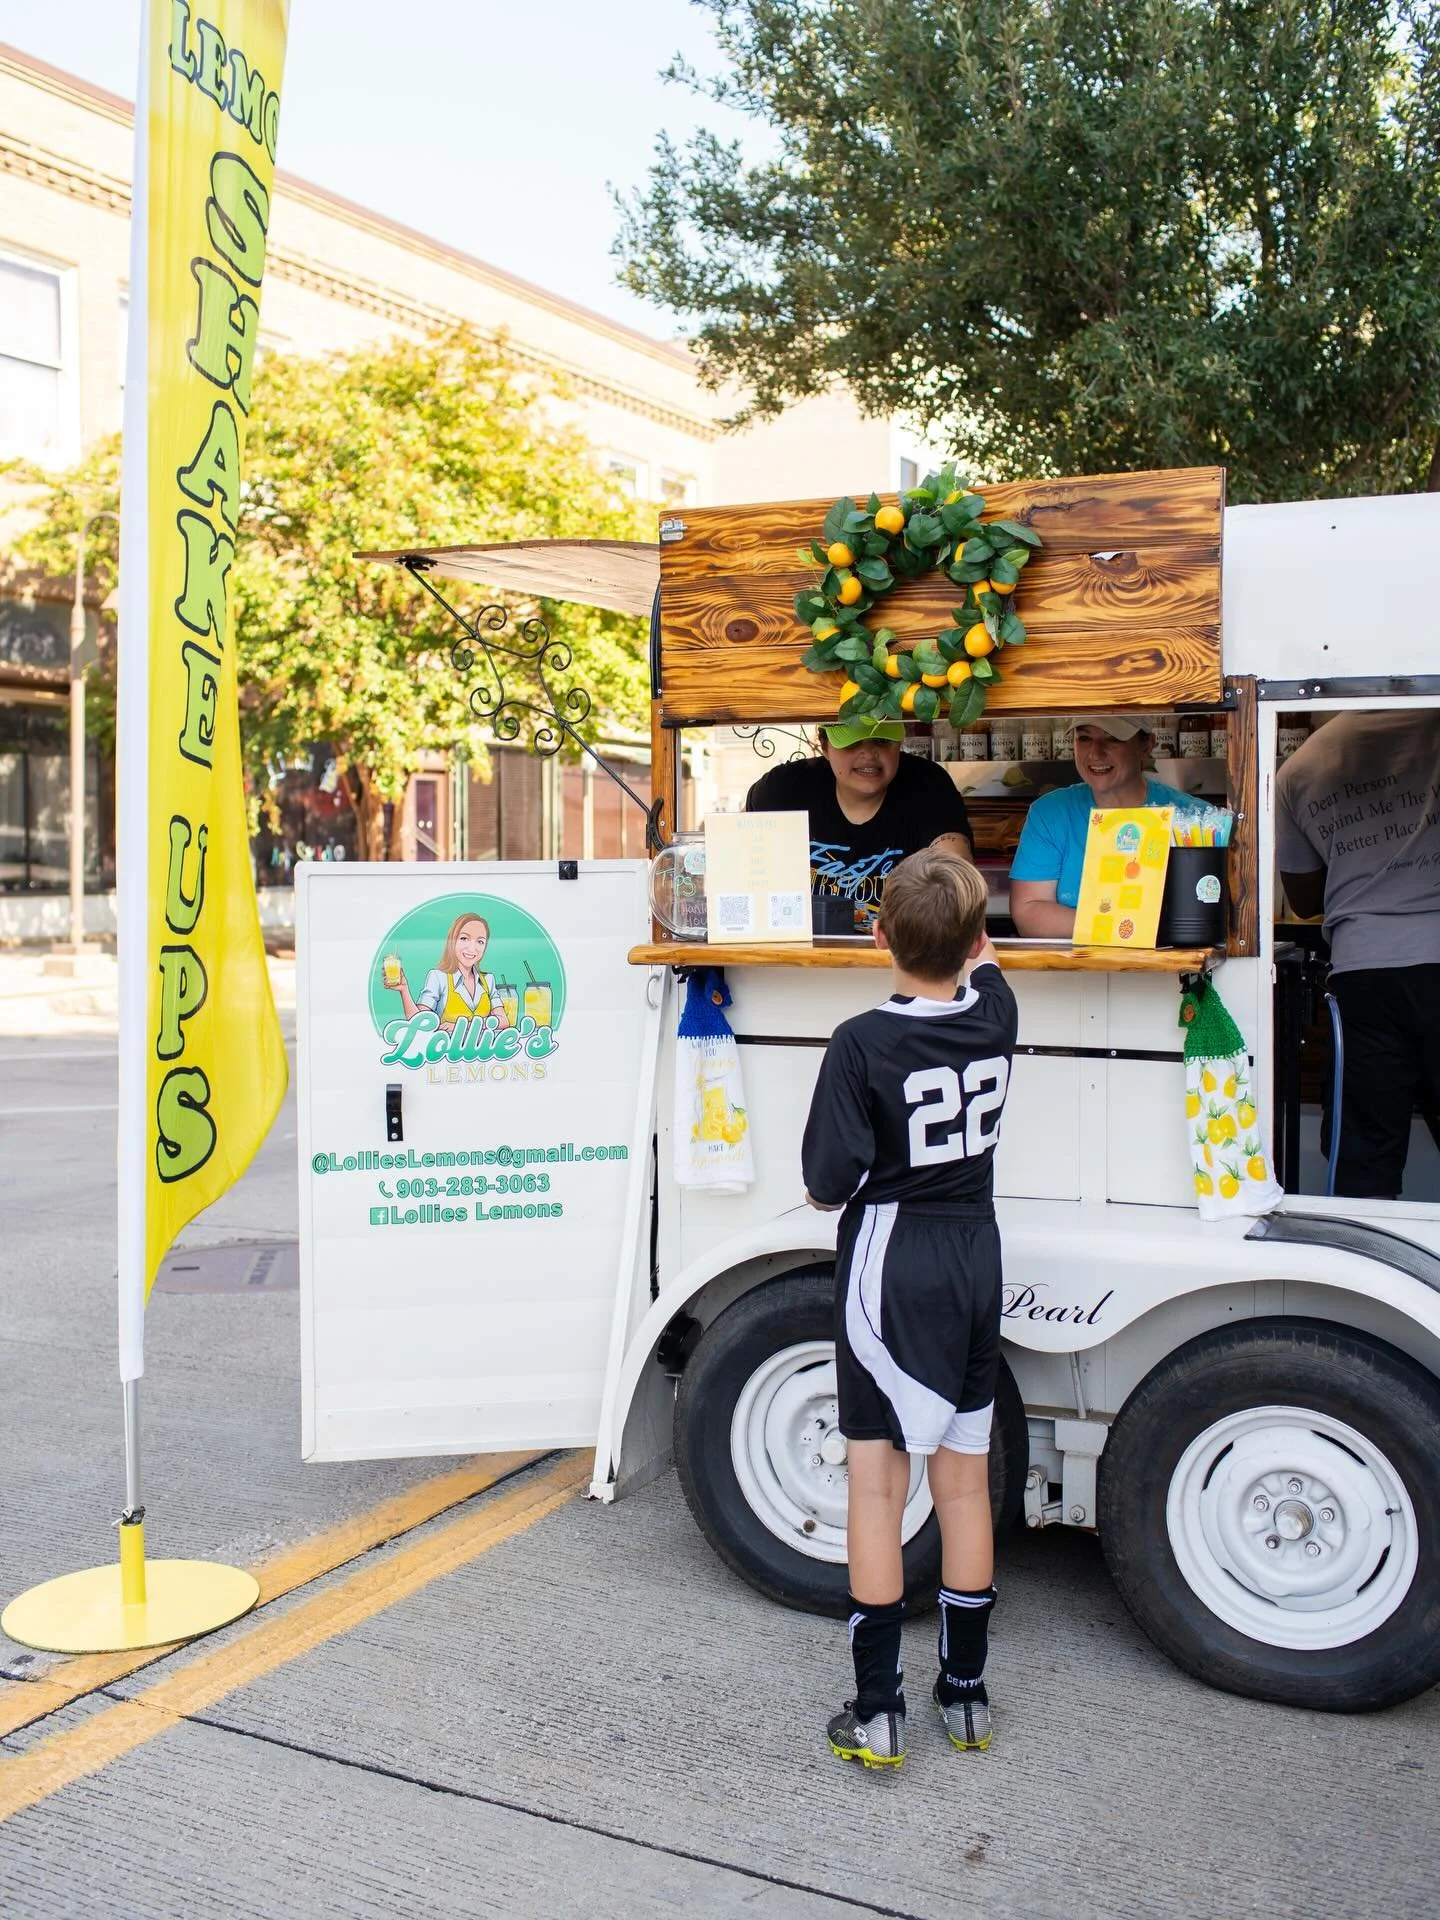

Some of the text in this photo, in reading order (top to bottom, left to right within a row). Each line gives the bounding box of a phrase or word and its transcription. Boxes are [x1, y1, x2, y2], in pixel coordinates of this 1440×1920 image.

[1307, 790, 1340, 818] Dear
[1343, 774, 1397, 799] Person
[1369, 800, 1393, 818] Me
[1395, 790, 1427, 809] The
[1335, 833, 1379, 856] Better
[810, 841, 904, 899] Fast
[380, 1009, 559, 1070] Lollie's
[426, 1061, 548, 1085] LEMONS
[903, 1055, 1009, 1168] 22
[312, 1143, 629, 1174] @LolliesLemons@gmail.com
[396, 1173, 551, 1199] 903-283-3063
[391, 1204, 468, 1225] Lollies
[475, 1201, 564, 1222] Lemons
[1001, 1282, 1114, 1325] Pearl
